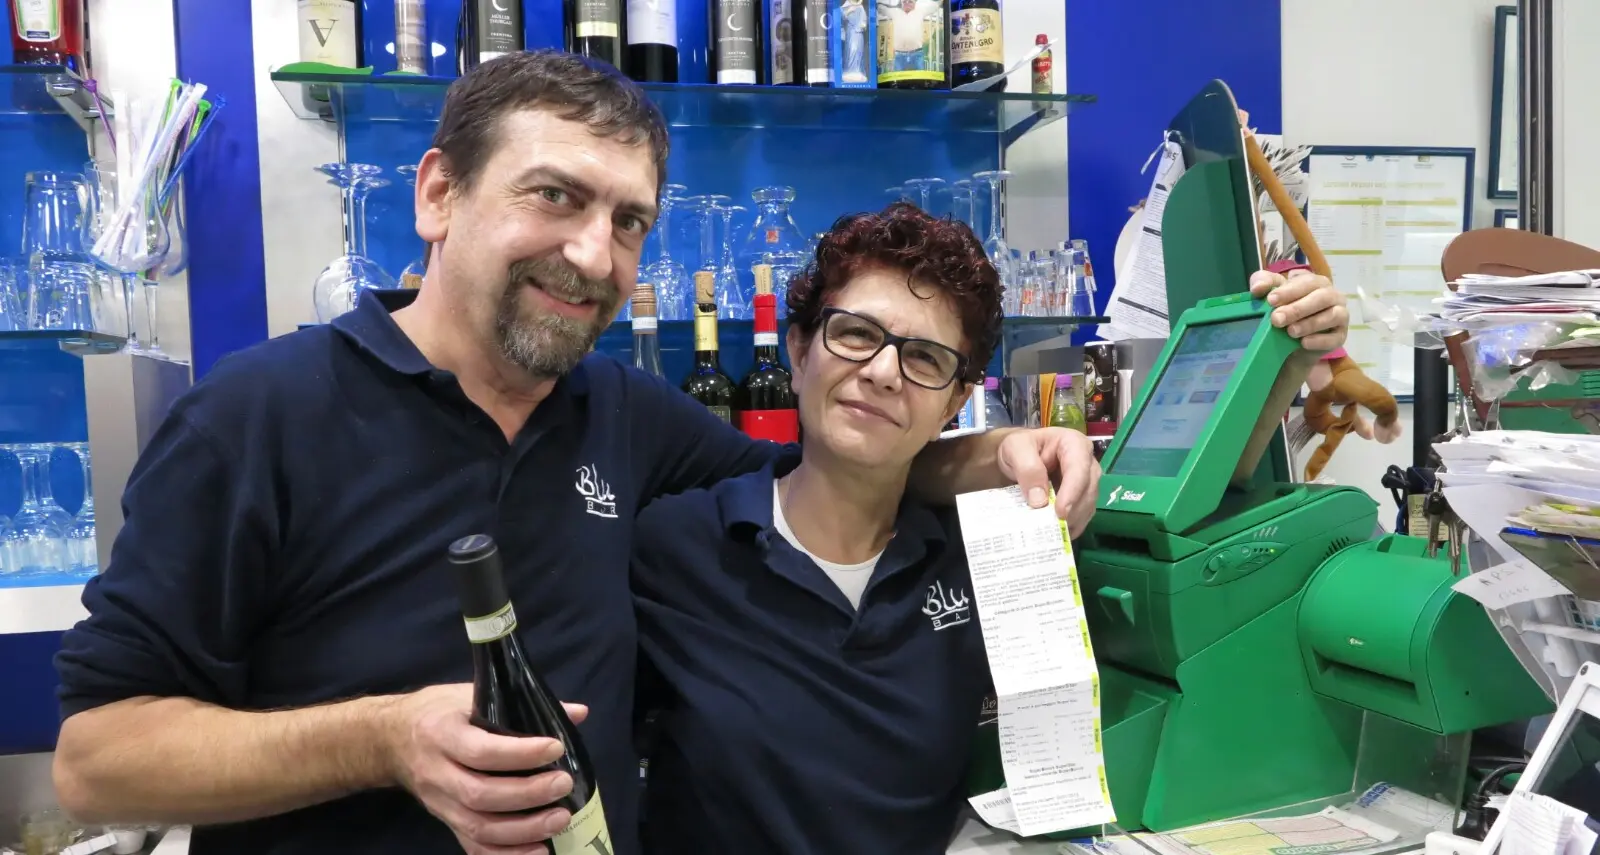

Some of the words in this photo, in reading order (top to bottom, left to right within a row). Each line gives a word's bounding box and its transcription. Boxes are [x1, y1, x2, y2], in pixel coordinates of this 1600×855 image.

[575, 463, 616, 501] Blu
[1121, 490, 1146, 501] Sisal
[921, 579, 970, 616] Blu
